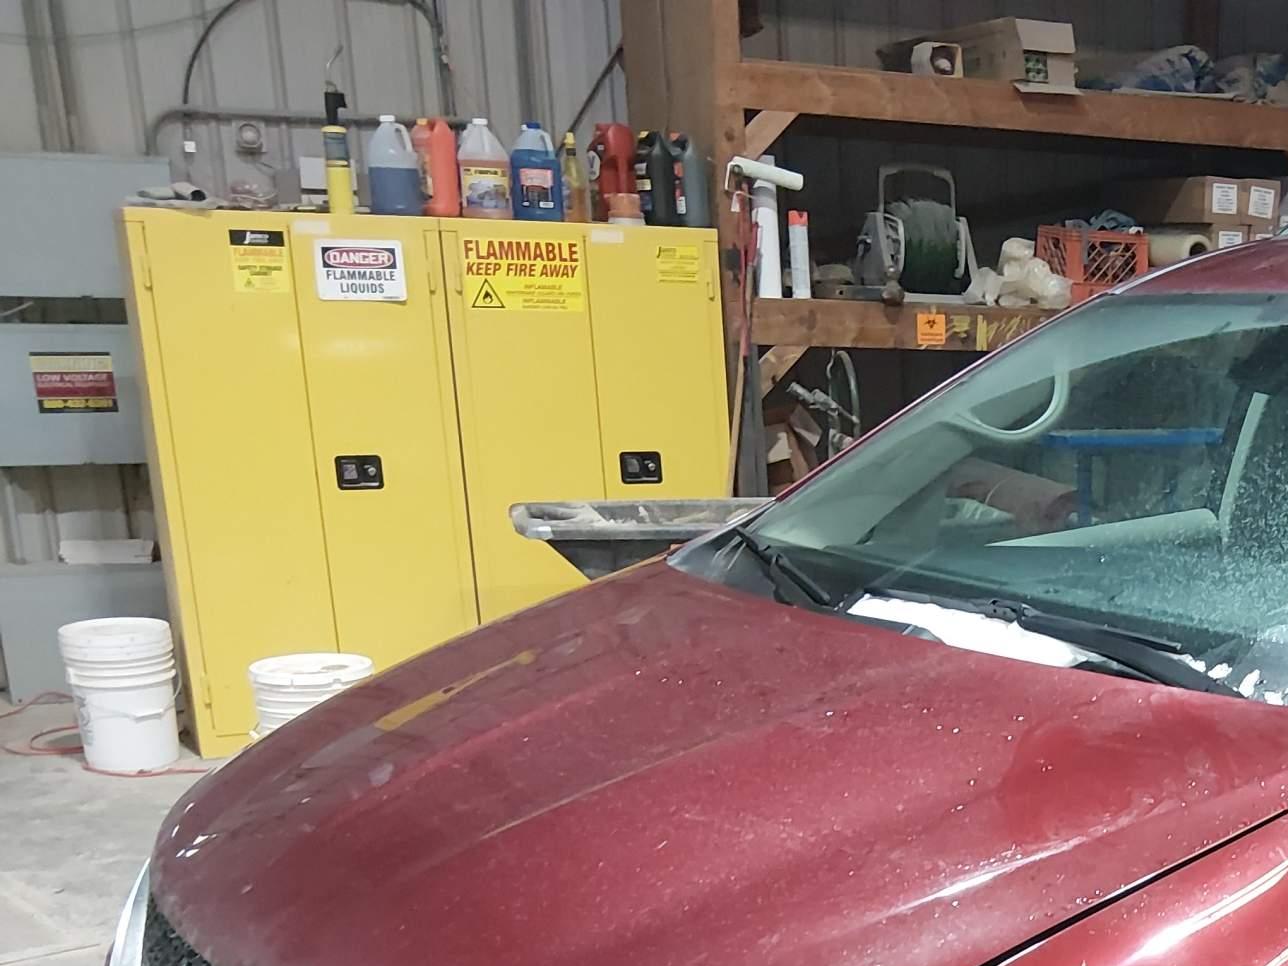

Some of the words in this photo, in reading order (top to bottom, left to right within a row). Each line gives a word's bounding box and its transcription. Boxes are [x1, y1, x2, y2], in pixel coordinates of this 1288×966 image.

[463, 239, 579, 262] FLAMMABLE
[329, 251, 389, 265] DANGER
[326, 270, 396, 282] FLAMMABLE
[466, 262, 502, 276] KEEP
[506, 263, 537, 277] FIRE
[539, 264, 578, 278] AWAY
[340, 283, 385, 294] LIQUIDS
[36, 373, 61, 381] LOW
